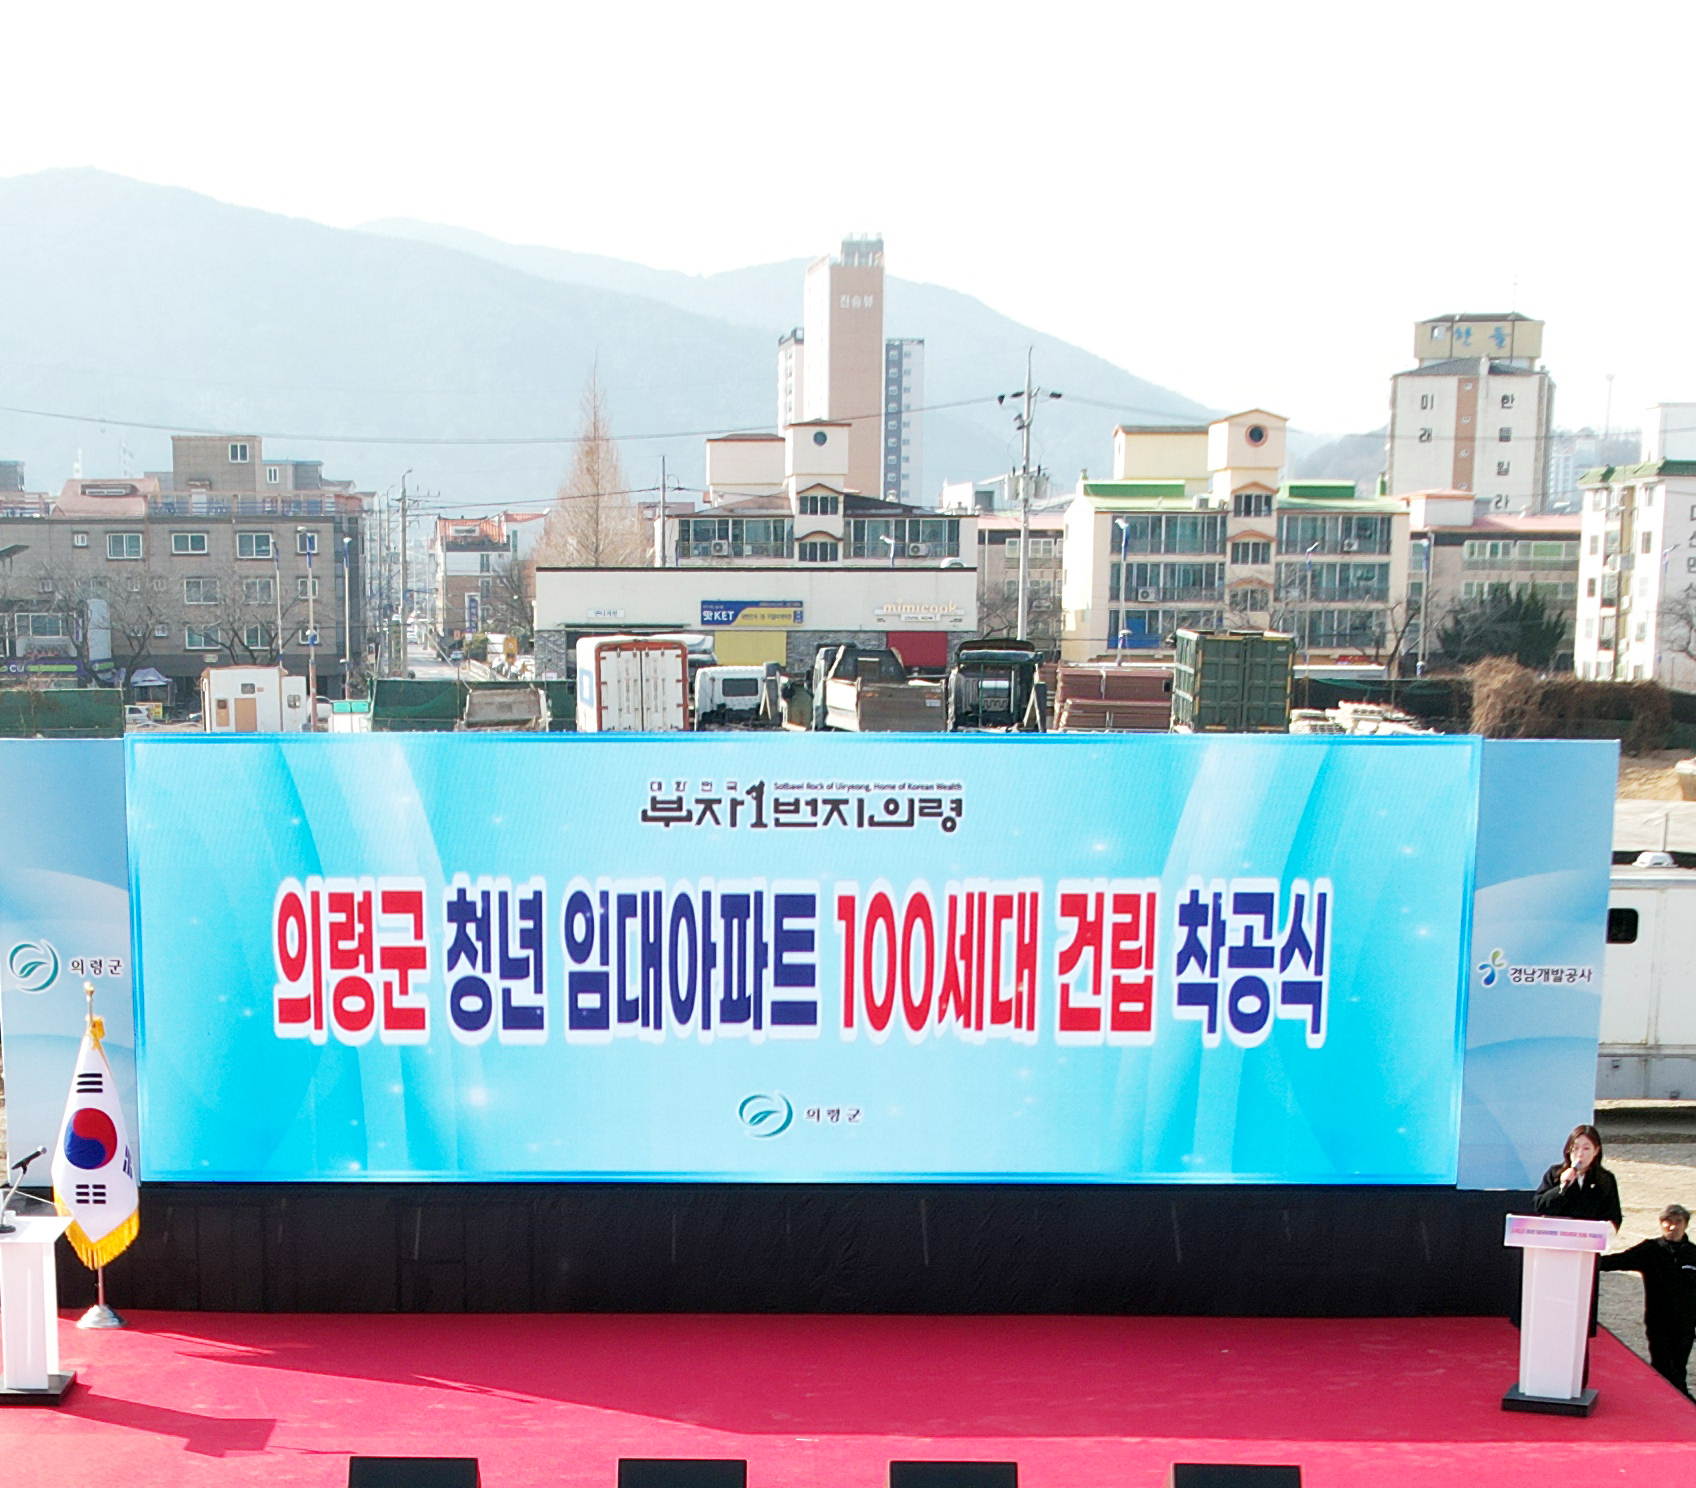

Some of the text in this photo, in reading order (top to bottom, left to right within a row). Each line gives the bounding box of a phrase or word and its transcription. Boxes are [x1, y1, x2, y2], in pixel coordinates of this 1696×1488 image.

[70, 958, 122, 976] 의령군
[277, 888, 1327, 1034] 의령군 청년 임대아파트 100세대 건립 착공식
[1510, 967, 1592, 983] 경남개발공사
[806, 1107, 861, 1123] 의령군
